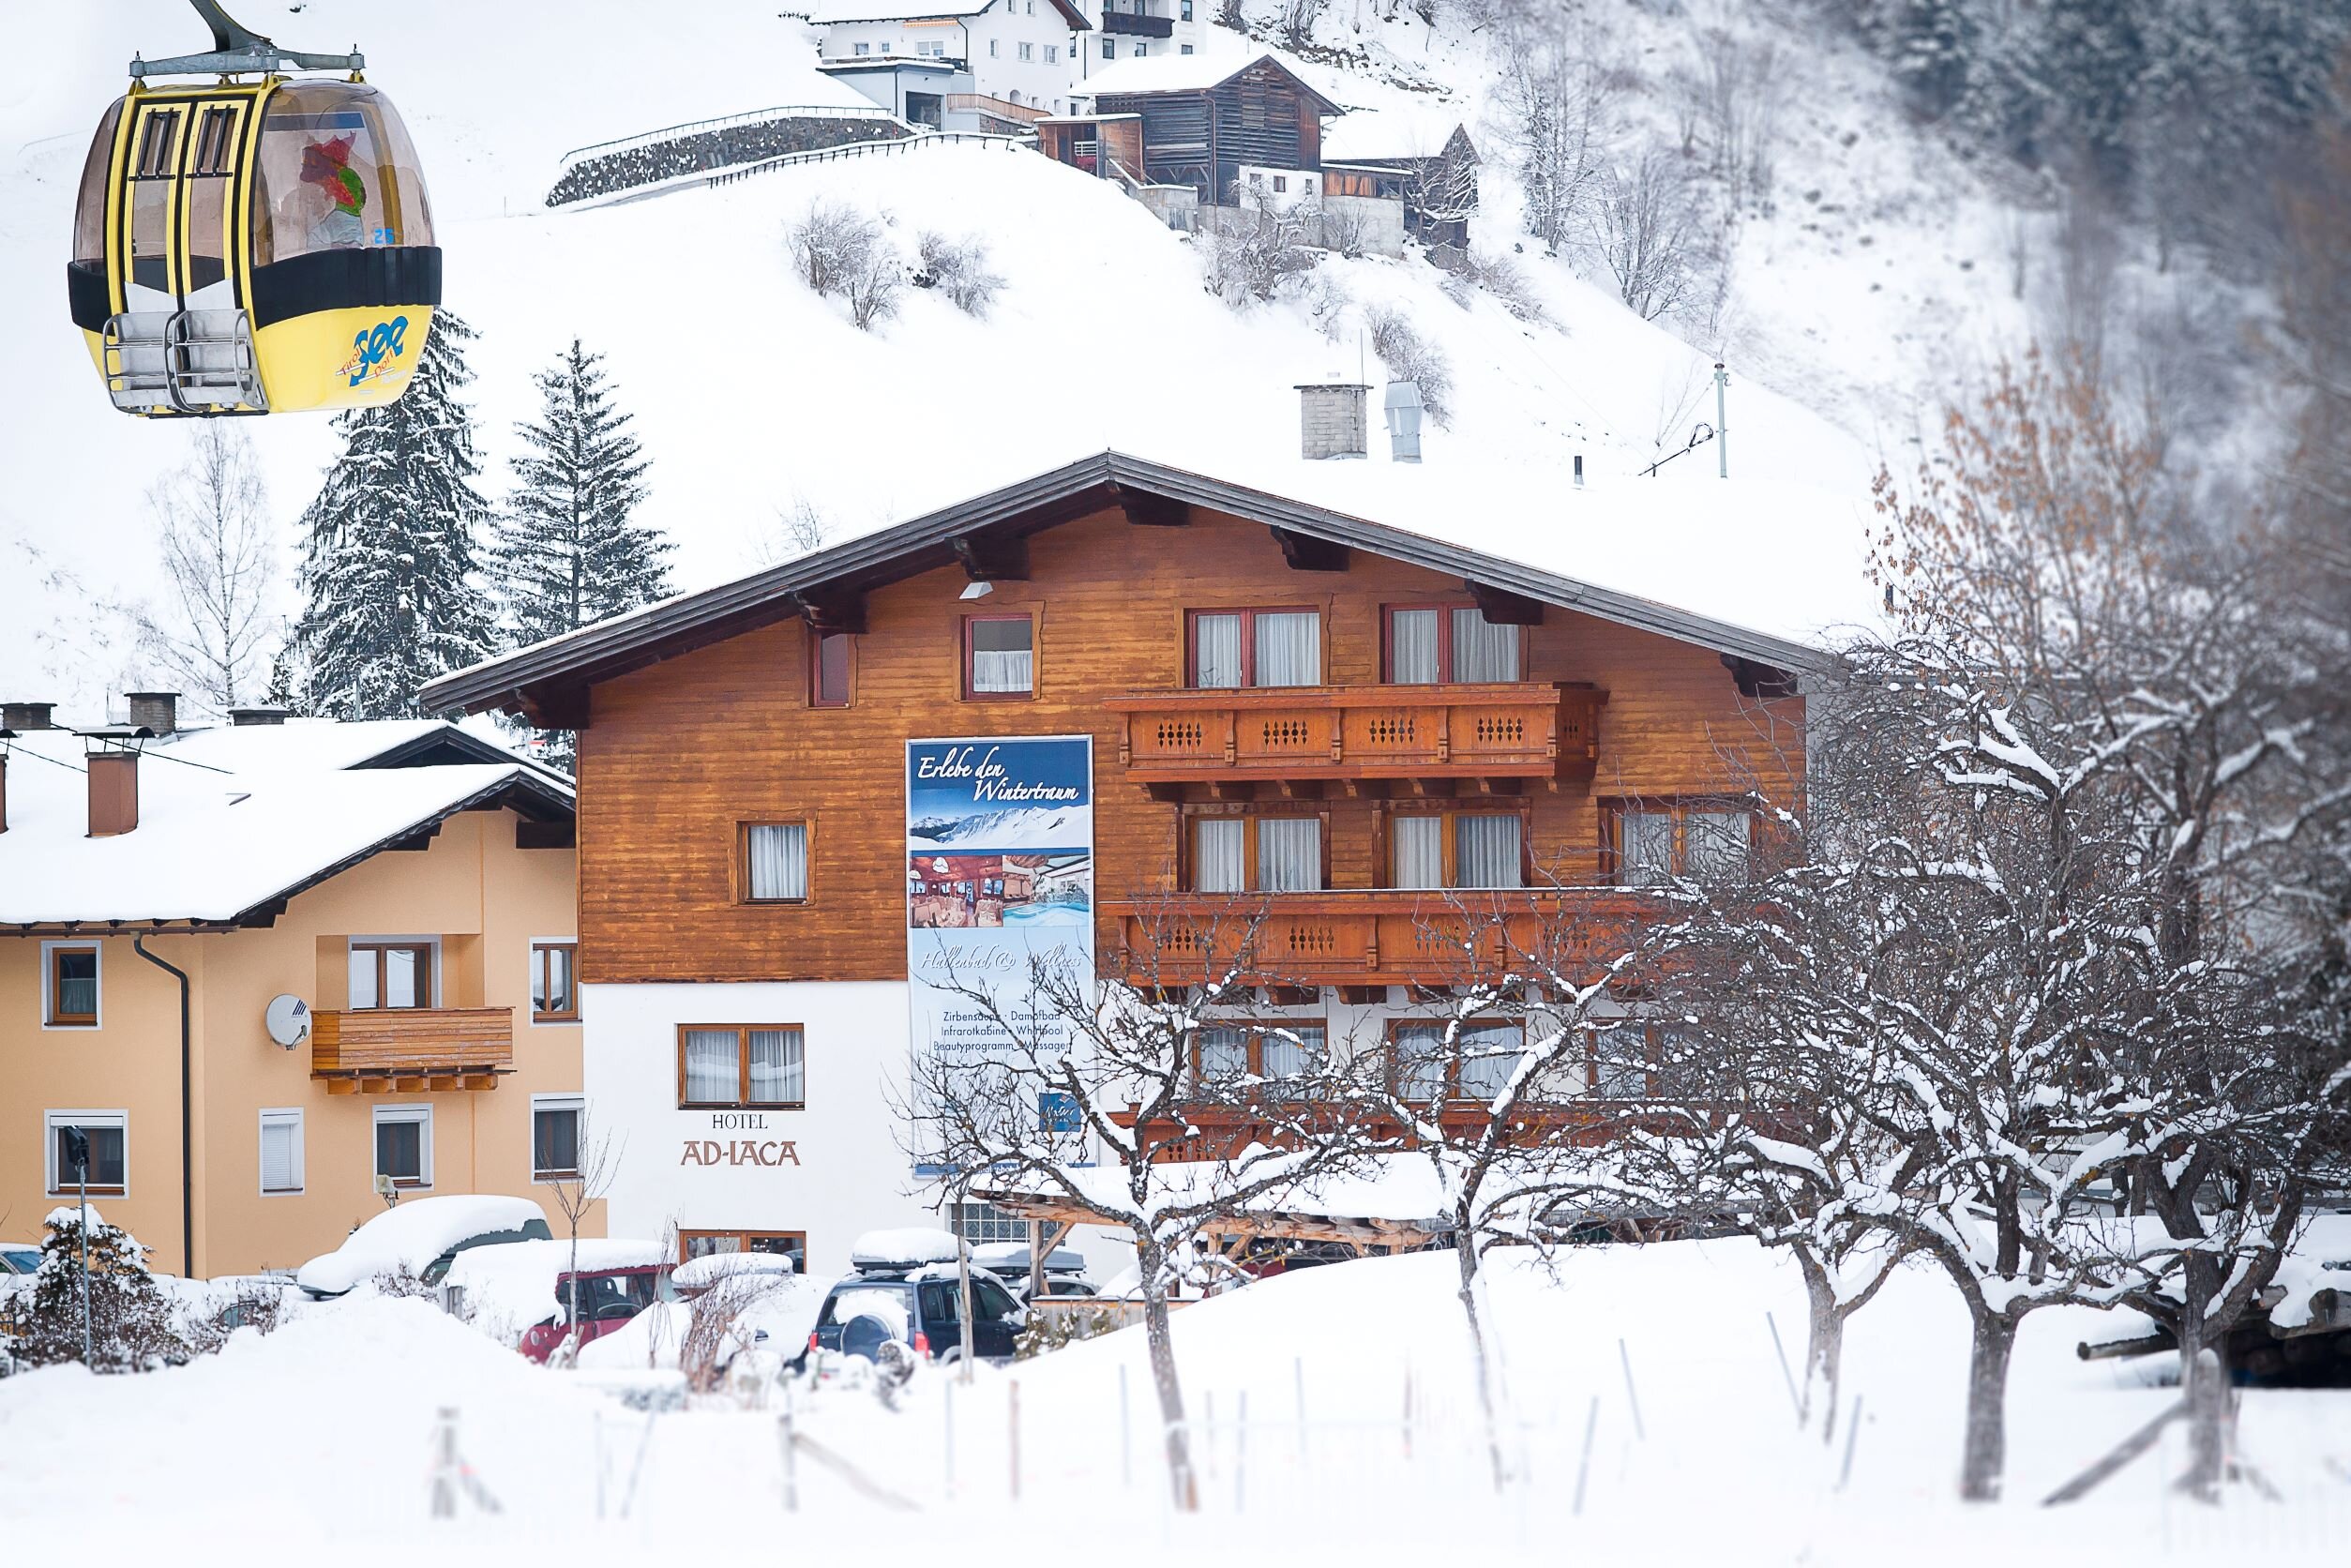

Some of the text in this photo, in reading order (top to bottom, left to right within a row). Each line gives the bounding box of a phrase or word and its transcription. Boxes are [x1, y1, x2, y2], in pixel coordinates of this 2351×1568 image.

[918, 746, 1005, 779] Erlebe den
[973, 776, 1079, 801] Wintertraum
[943, 1010, 1001, 1022] Zirbensaun
[941, 1023, 1063, 1038] Infrarotkabine Whrlpool
[933, 1041, 1014, 1053] Beautyprogramm
[713, 1113, 768, 1129] HOTEL
[680, 1140, 801, 1166] AD-LACA
